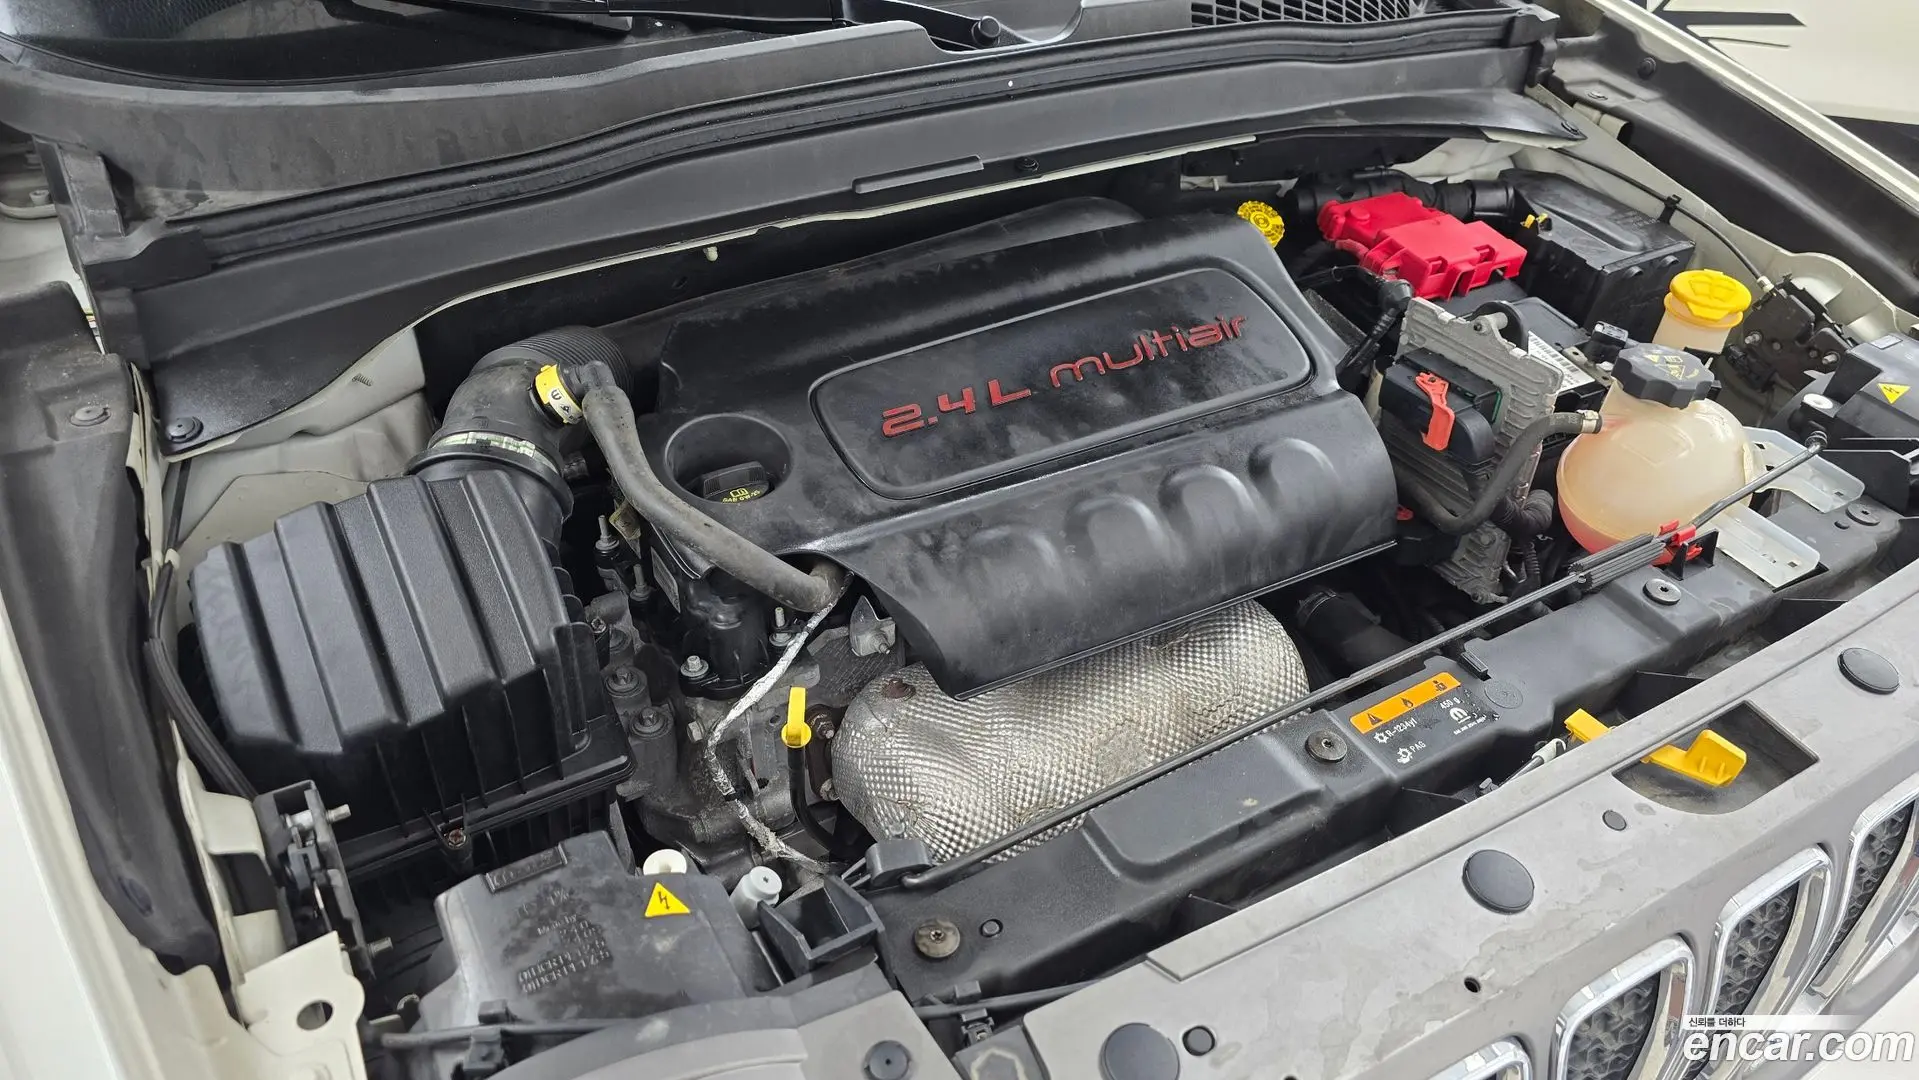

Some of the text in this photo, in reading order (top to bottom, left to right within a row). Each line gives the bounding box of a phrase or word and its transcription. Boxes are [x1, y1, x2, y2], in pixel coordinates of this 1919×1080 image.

[1049, 314, 1247, 388] multiair
[1440, 699, 1453, 710] 450
[1410, 741, 1426, 753] PAG
